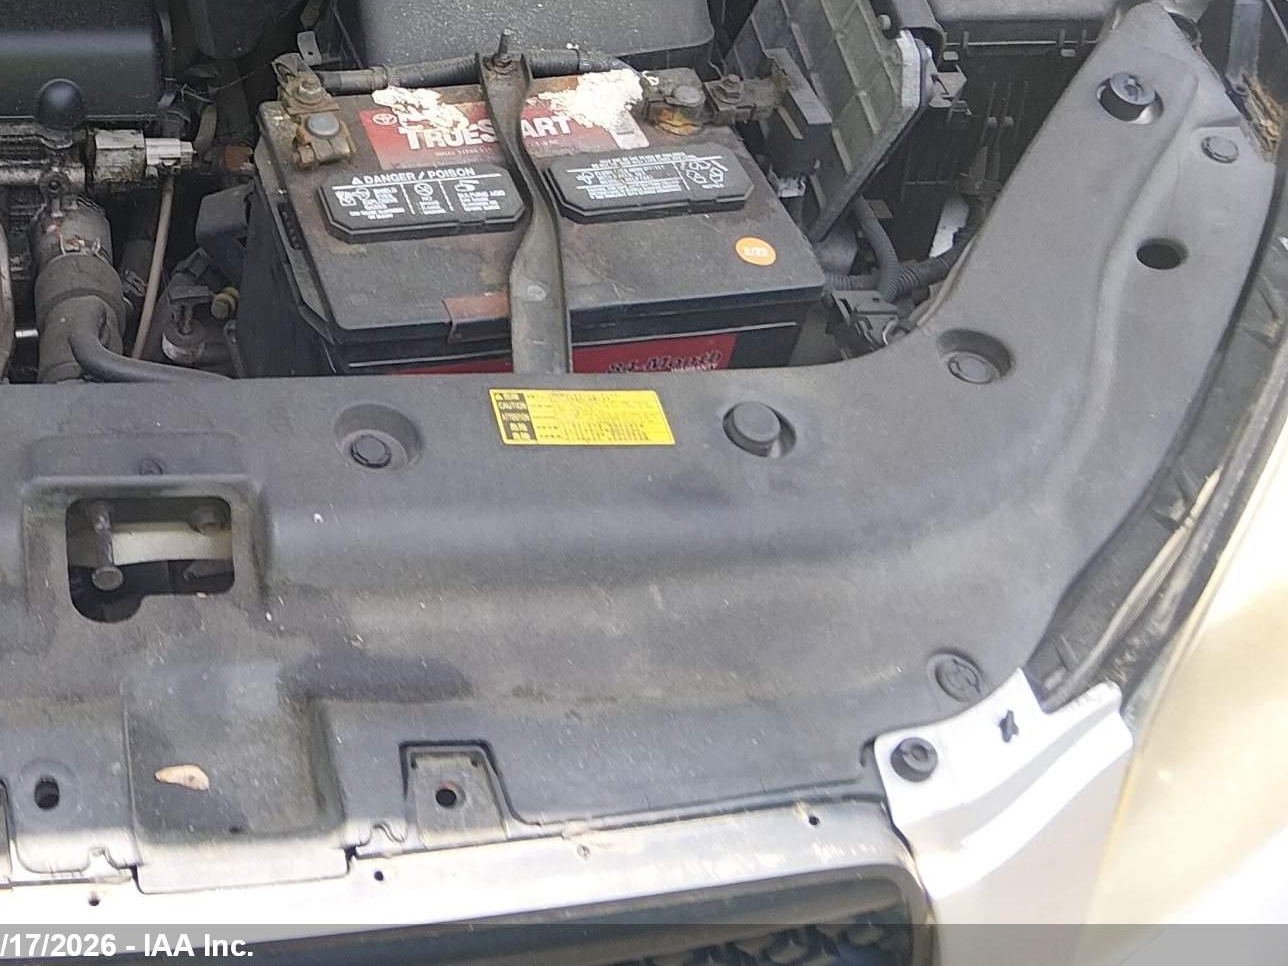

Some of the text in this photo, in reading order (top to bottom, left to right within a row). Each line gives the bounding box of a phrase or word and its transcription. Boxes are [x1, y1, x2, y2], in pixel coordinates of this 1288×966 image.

[363, 172, 416, 185] DANGER
[428, 167, 476, 180] POISON
[497, 401, 528, 411] CAUTION
